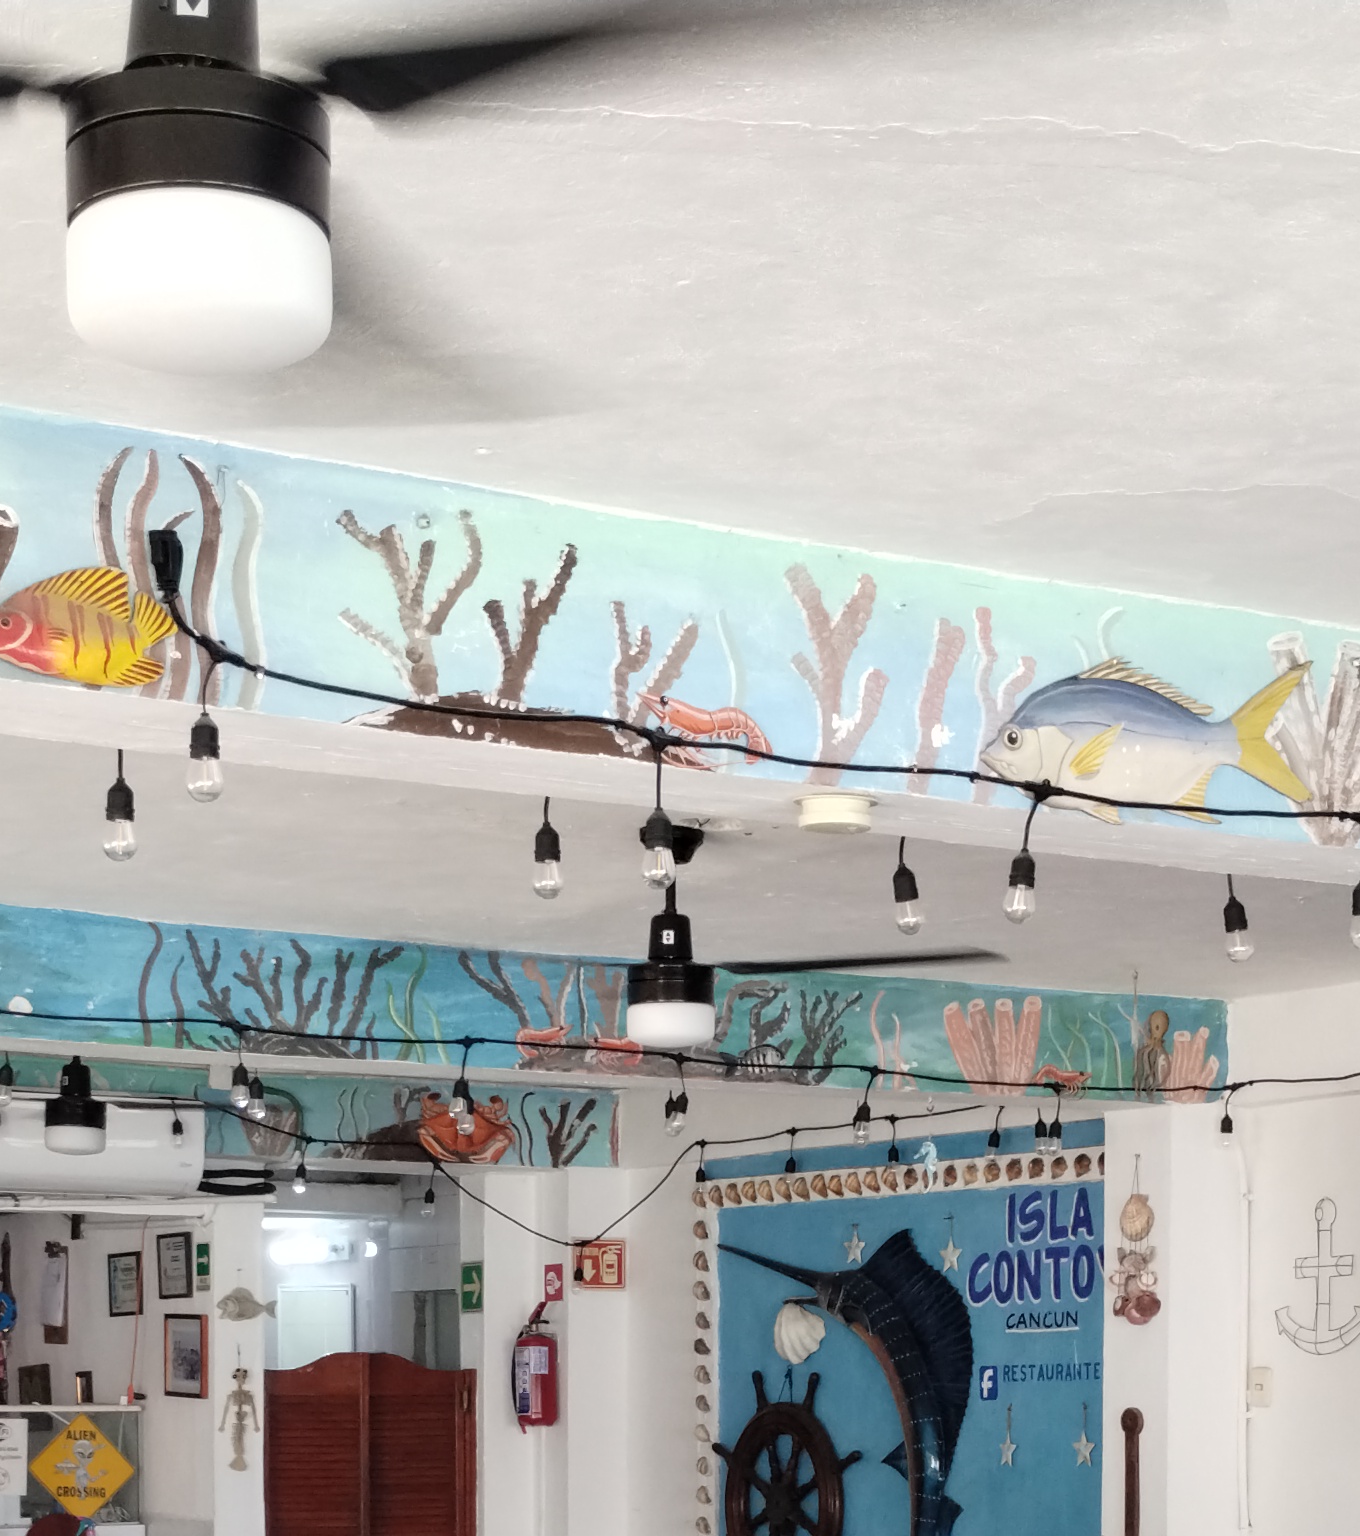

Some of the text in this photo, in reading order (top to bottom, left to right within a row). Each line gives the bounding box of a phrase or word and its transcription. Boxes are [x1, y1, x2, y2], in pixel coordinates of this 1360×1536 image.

[1006, 1187, 1095, 1247] ISLA
[1005, 1310, 1079, 1329] CANCUN
[1002, 1362, 1101, 1382] RESTAURANTE
[66, 1430, 96, 1440] ALIEN
[56, 1486, 106, 1498] CROSSING
